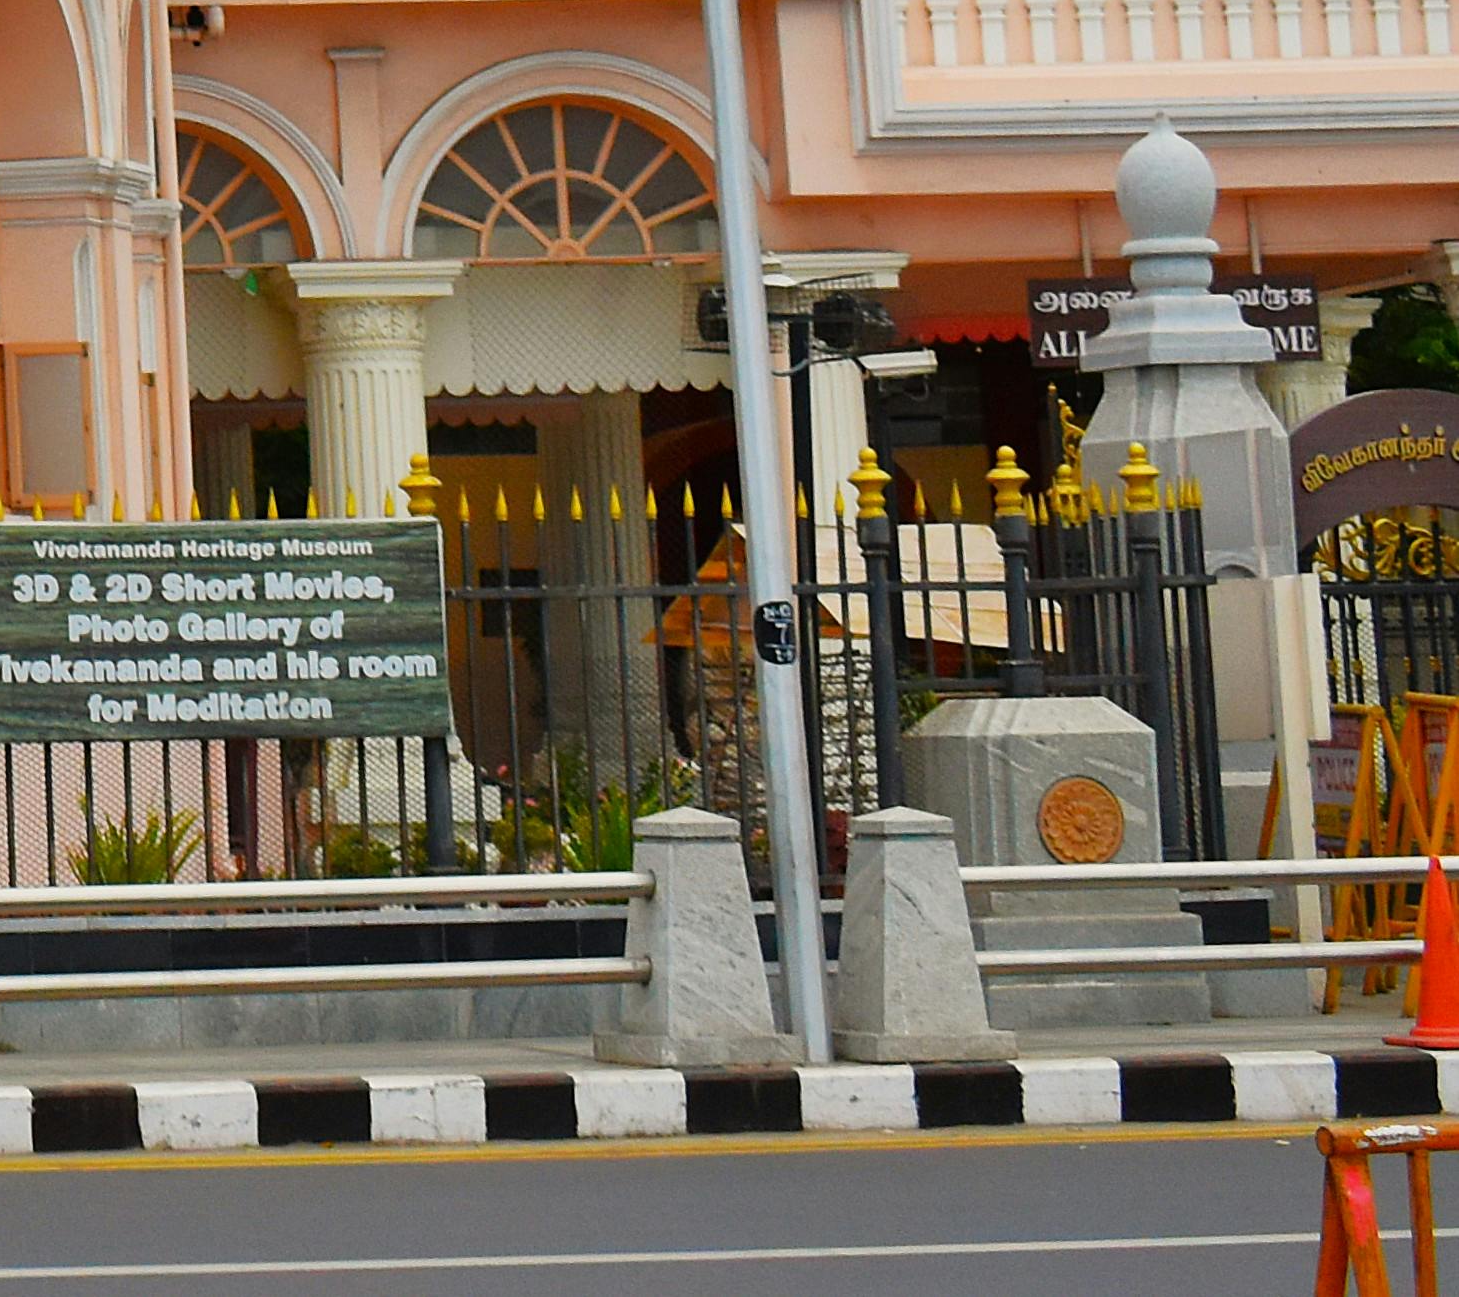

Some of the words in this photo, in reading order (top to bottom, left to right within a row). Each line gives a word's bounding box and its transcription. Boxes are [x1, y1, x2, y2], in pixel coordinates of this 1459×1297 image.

[1233, 284, 1313, 312] வருக
[1301, 423, 1446, 492] விவேகானந்தர்
[33, 540, 175, 559] Vivekananda
[181, 539, 276, 561] Heritage
[281, 538, 373, 556] Museum
[13, 574, 60, 603] 3D
[68, 573, 98, 603] &
[105, 573, 153, 603] 2D
[161, 572, 256, 602] Short
[263, 570, 394, 604] Movies,
[67, 613, 170, 643] Photo
[177, 612, 303, 647] Gallery
[309, 609, 345, 640] of
[212, 651, 278, 681] and
[286, 650, 340, 680] his
[348, 654, 437, 679] room
[87, 693, 138, 724] for
[146, 691, 333, 722] Meditation
